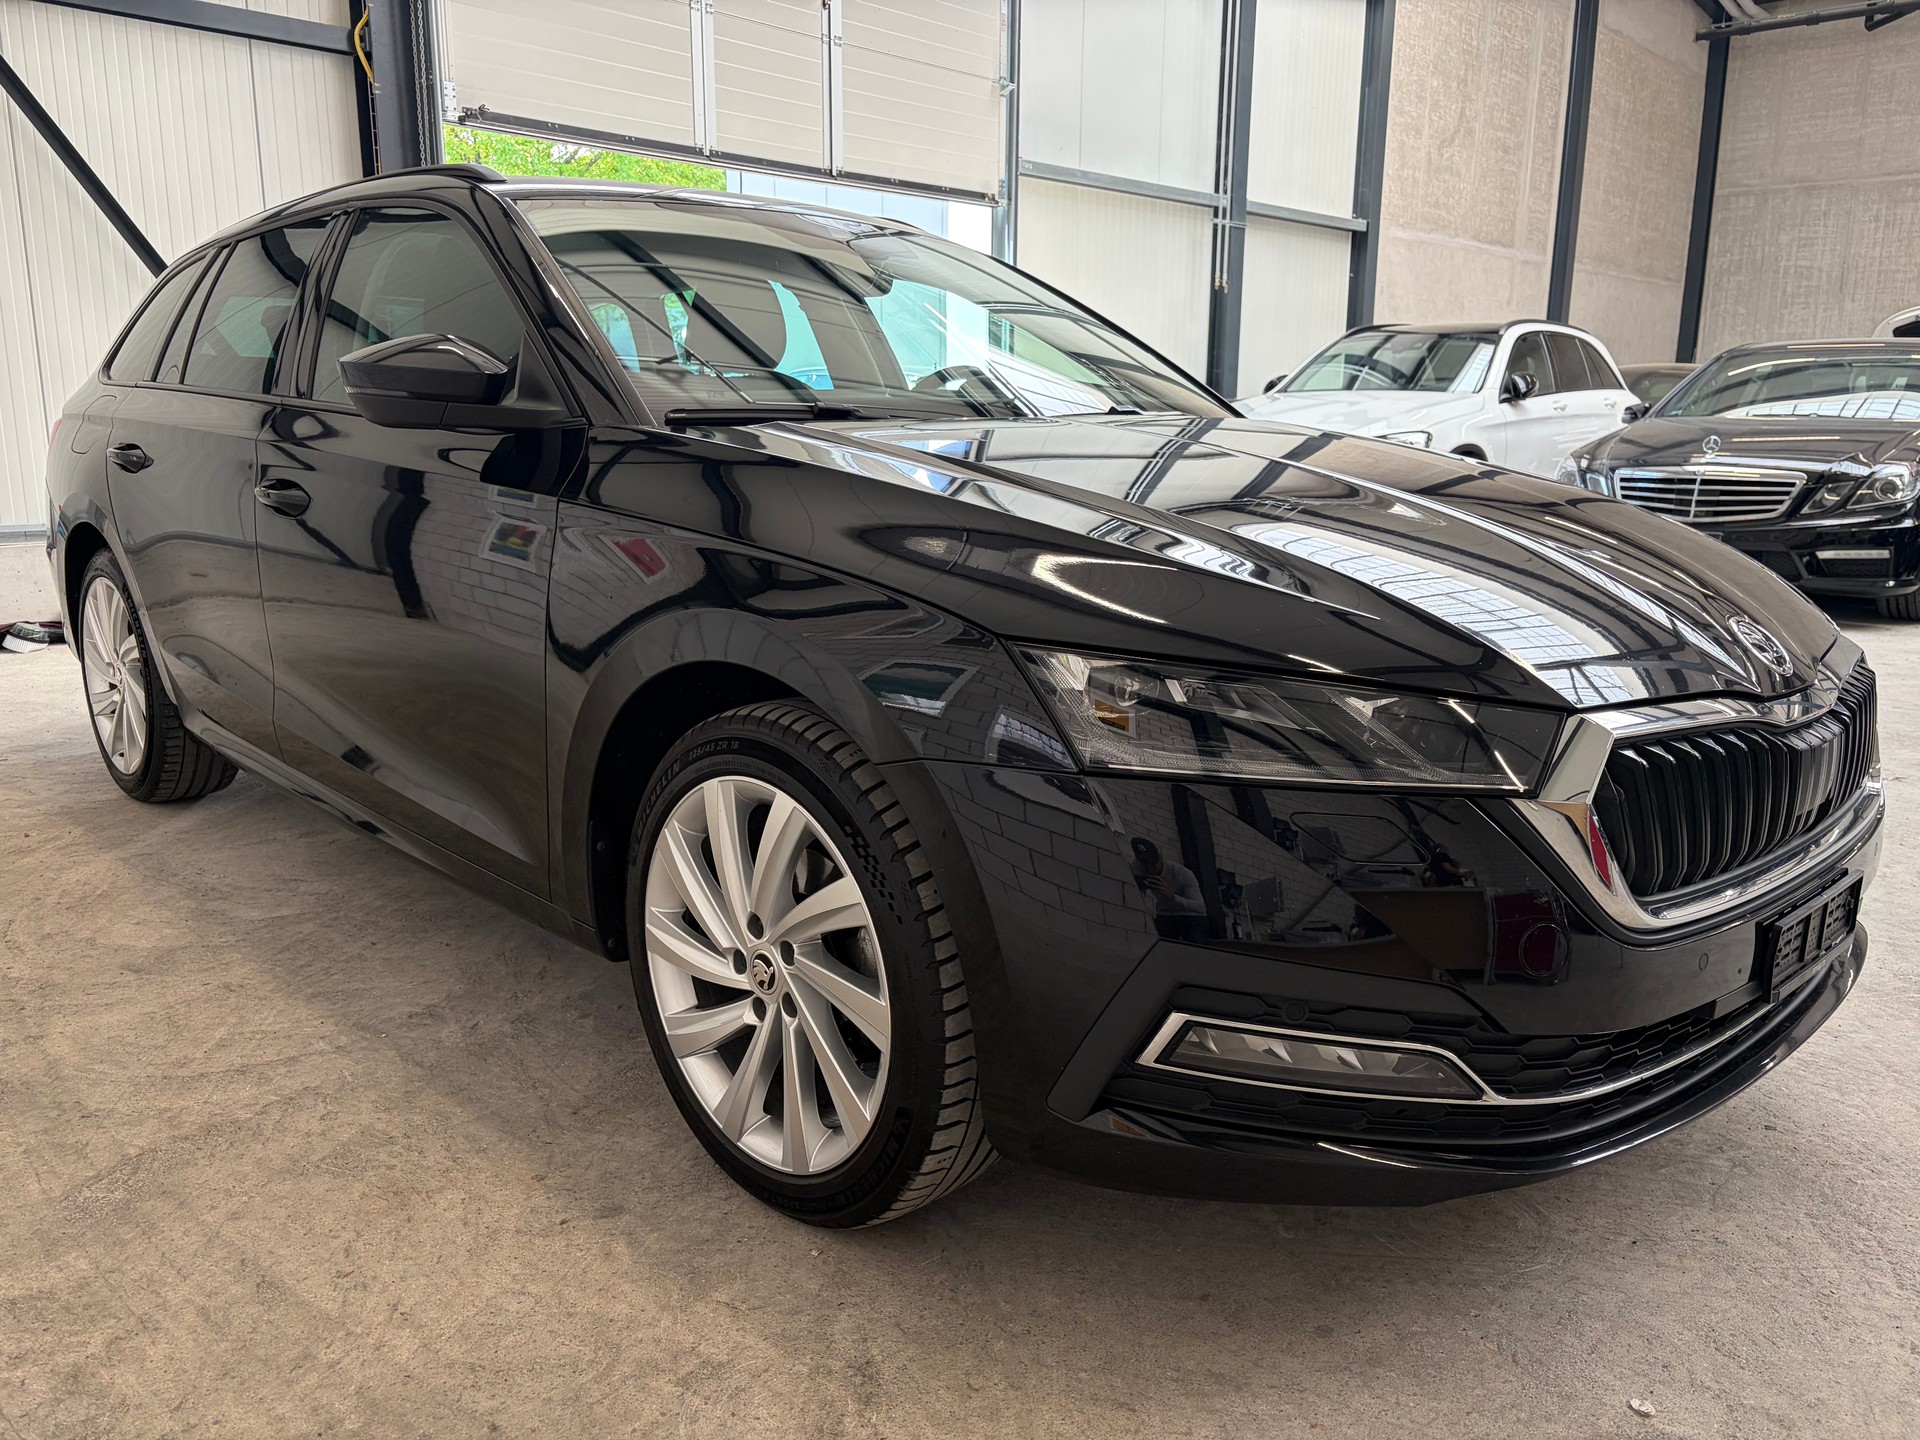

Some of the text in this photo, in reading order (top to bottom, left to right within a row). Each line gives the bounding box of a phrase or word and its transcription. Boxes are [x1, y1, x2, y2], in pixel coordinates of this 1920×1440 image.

[688, 740, 740, 761] 225/45 ZR 18
[635, 758, 681, 842] MICHELIN
